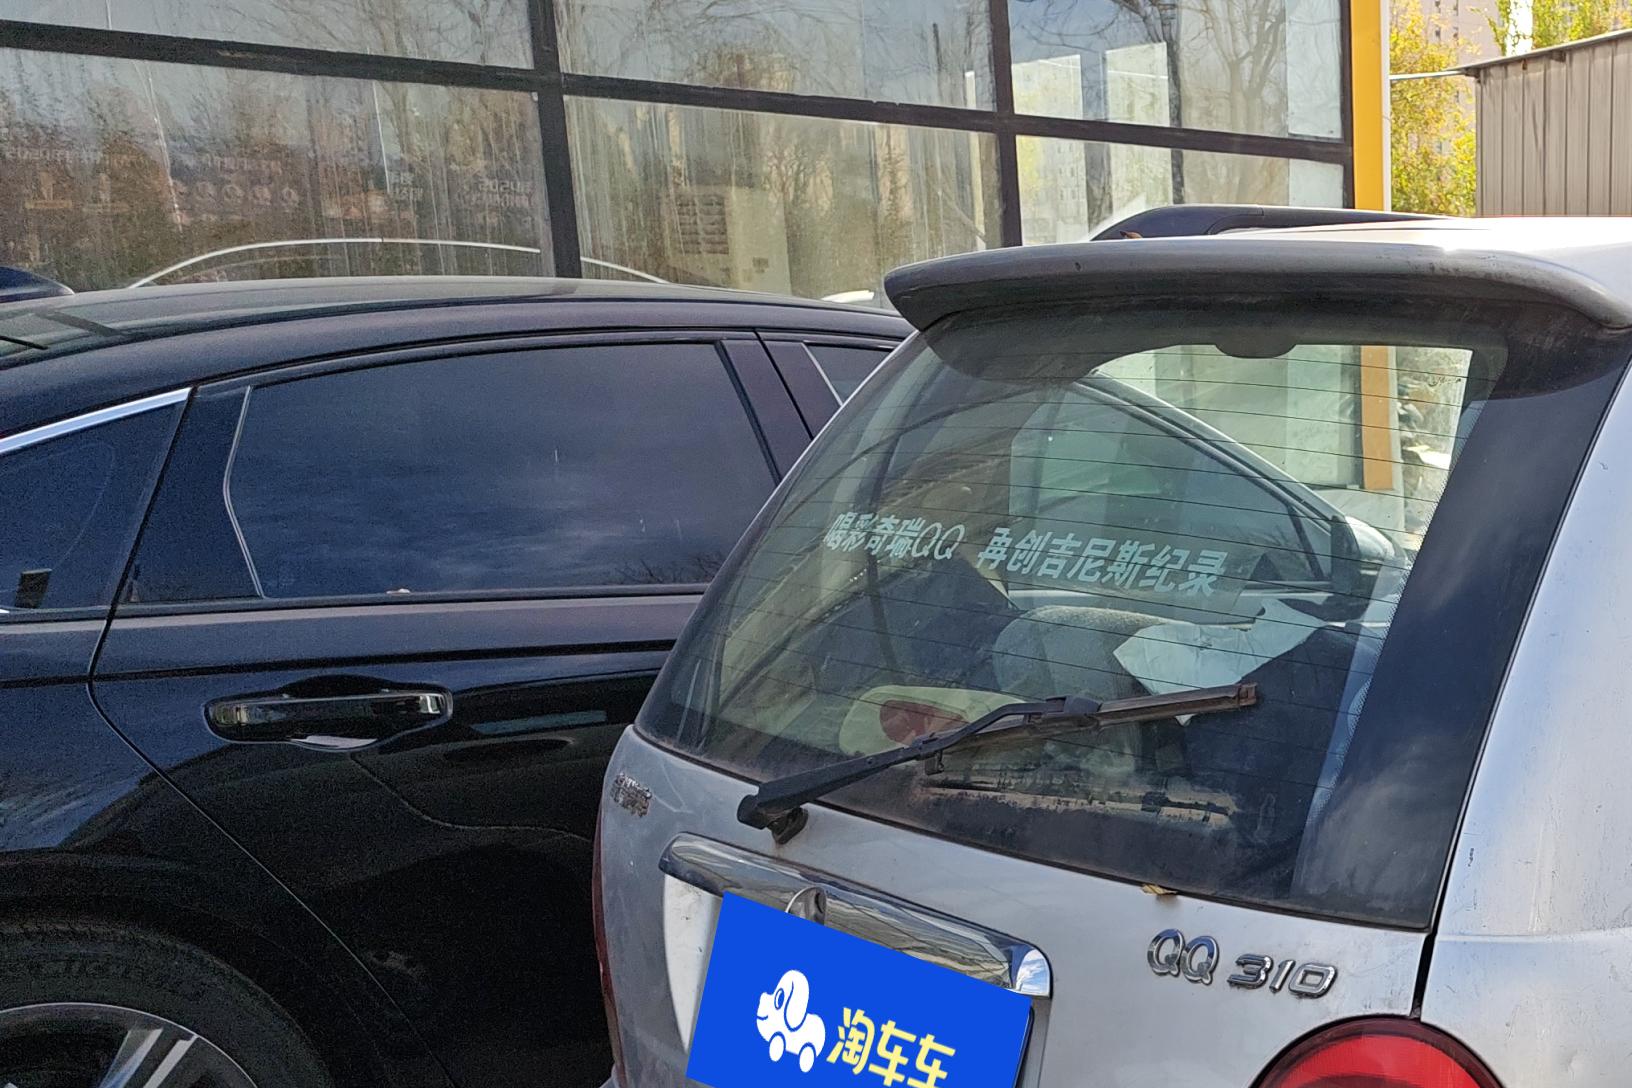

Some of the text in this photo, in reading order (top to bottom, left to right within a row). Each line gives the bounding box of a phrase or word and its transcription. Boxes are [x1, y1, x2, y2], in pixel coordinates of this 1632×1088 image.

[976, 527, 1228, 597] 再创吉尼斯纪录
[1147, 928, 1338, 999] QQ 310
